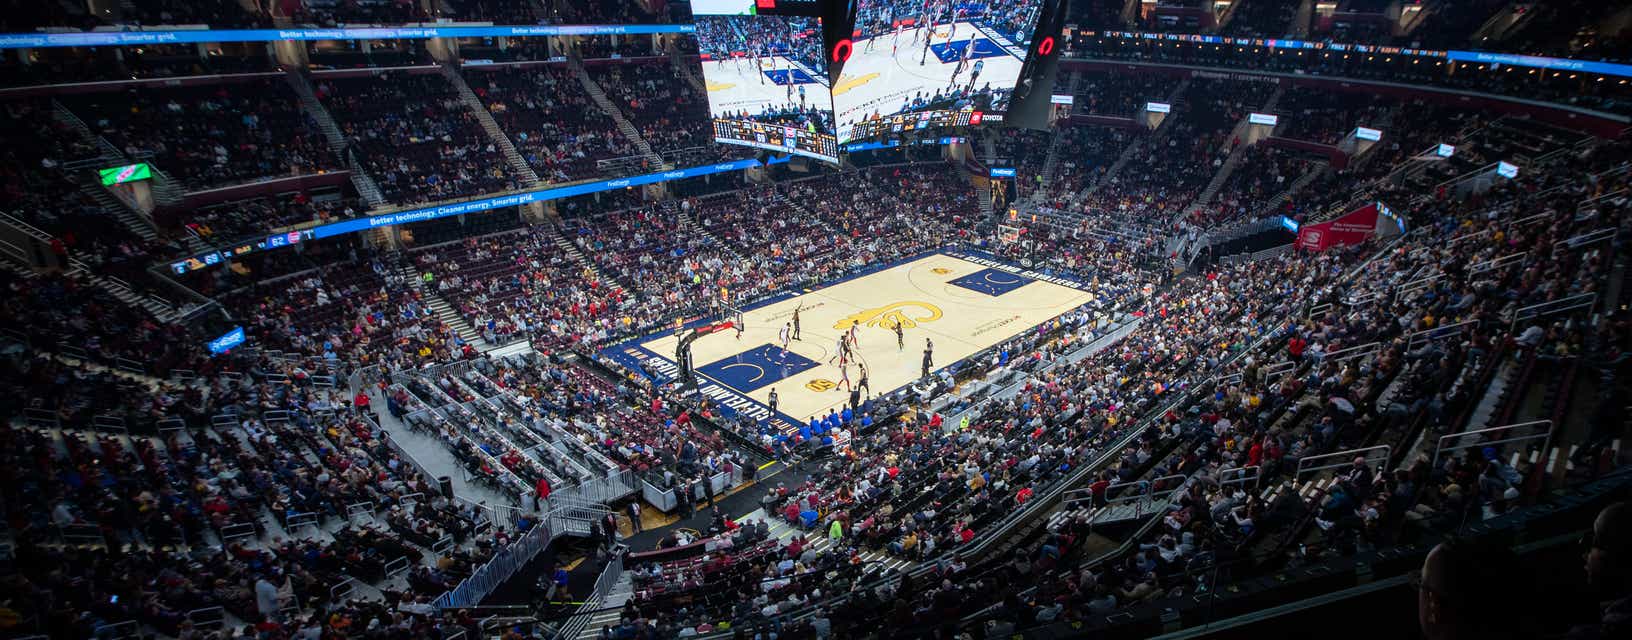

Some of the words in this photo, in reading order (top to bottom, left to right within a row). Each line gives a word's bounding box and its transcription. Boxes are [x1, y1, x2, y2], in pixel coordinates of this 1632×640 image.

[370, 216, 394, 226] Better
[396, 209, 436, 222] technology.
[438, 204, 465, 215] Cleaner
[466, 201, 490, 211] energy.
[491, 197, 518, 207] Smarter
[519, 194, 534, 204] grid.
[272, 237, 284, 246] 62
[964, 255, 1022, 273] CLEVELAND
[1021, 270, 1082, 289] CAVALIERS
[699, 384, 771, 421] CLEVELAND
